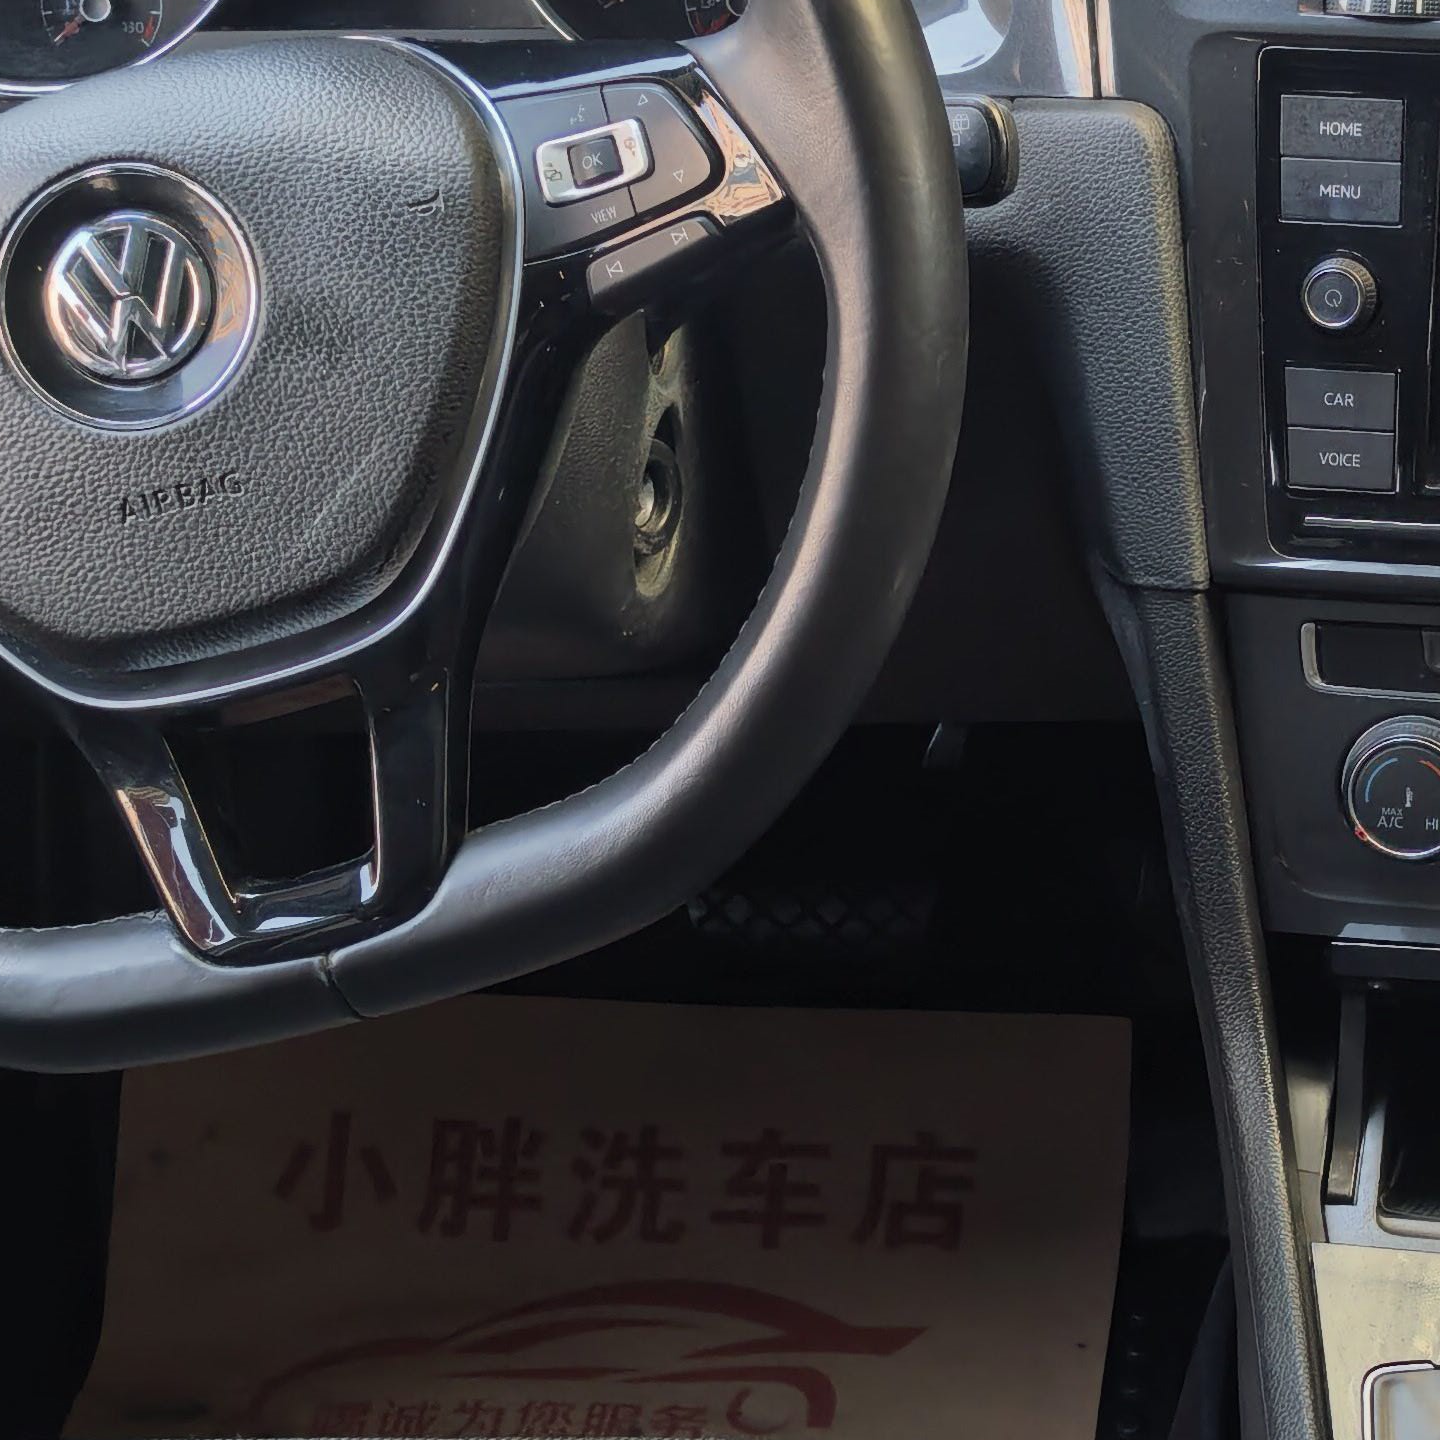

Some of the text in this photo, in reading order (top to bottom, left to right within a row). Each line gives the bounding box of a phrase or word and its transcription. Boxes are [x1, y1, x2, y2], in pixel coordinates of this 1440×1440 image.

[1319, 121, 1363, 137] HOME
[581, 152, 605, 170] OK
[1319, 184, 1361, 199] MENU
[589, 205, 618, 225] VIEW
[1323, 392, 1354, 407] CAR
[1319, 452, 1361, 468] VOICE
[120, 471, 244, 524] AIRBAG
[1381, 807, 1403, 817] MAX
[1376, 816, 1404, 829] A/C
[1425, 817, 1439, 831] HI
[275, 1110, 978, 1252] 小胖洗车店
